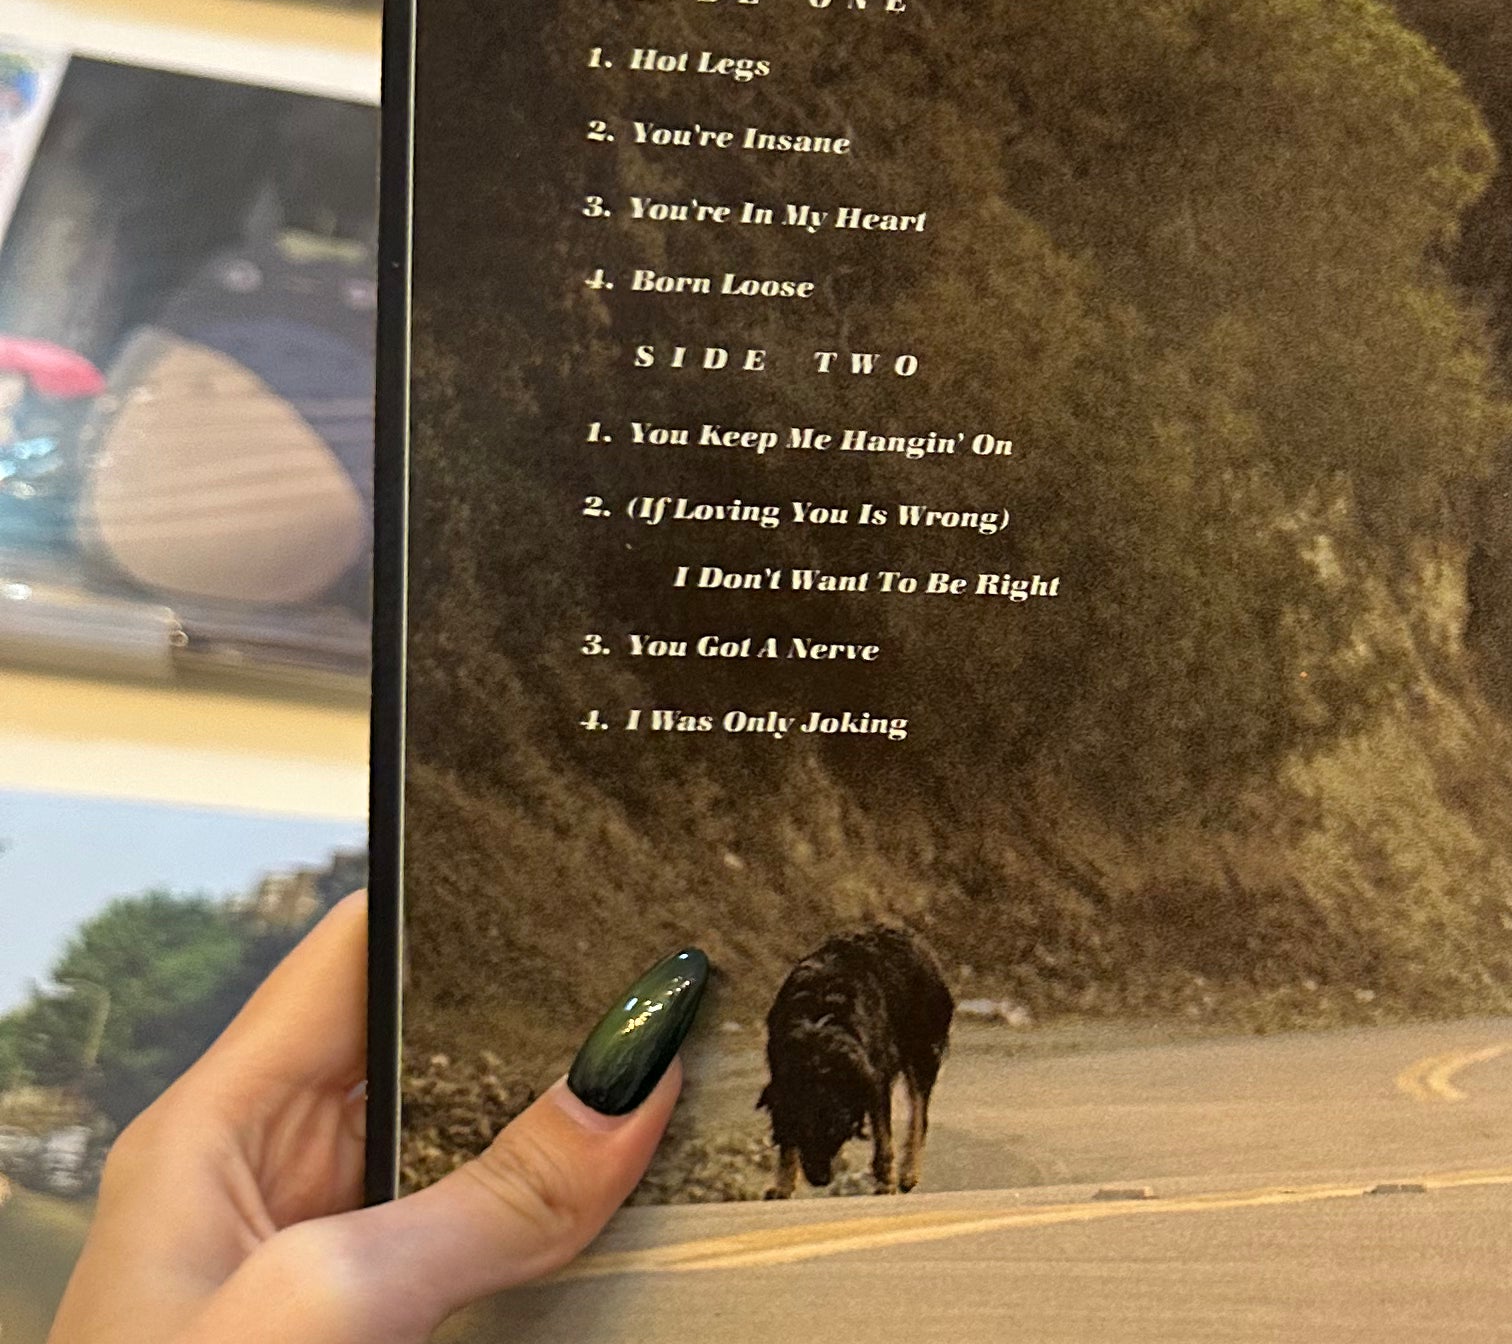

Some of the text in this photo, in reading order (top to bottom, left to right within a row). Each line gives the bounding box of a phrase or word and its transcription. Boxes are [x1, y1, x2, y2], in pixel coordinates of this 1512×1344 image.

[589, 48, 769, 81] 1. Hot Legs
[588, 121, 850, 154] 2. You're Insane
[583, 196, 926, 233] 3. You're In My Heart
[585, 269, 814, 297] 4. Born Loose
[635, 346, 917, 376] SIDE TWO
[587, 422, 1012, 458] 1. You Keep Me Hangin' On
[583, 497, 1009, 534] 2. (If Loving You Is Wrong)
[674, 567, 1059, 601] I Don't Want To Be Right
[581, 635, 879, 660] 3. You Got A Nerve
[580, 710, 907, 740] 4. I Was Only Joking
